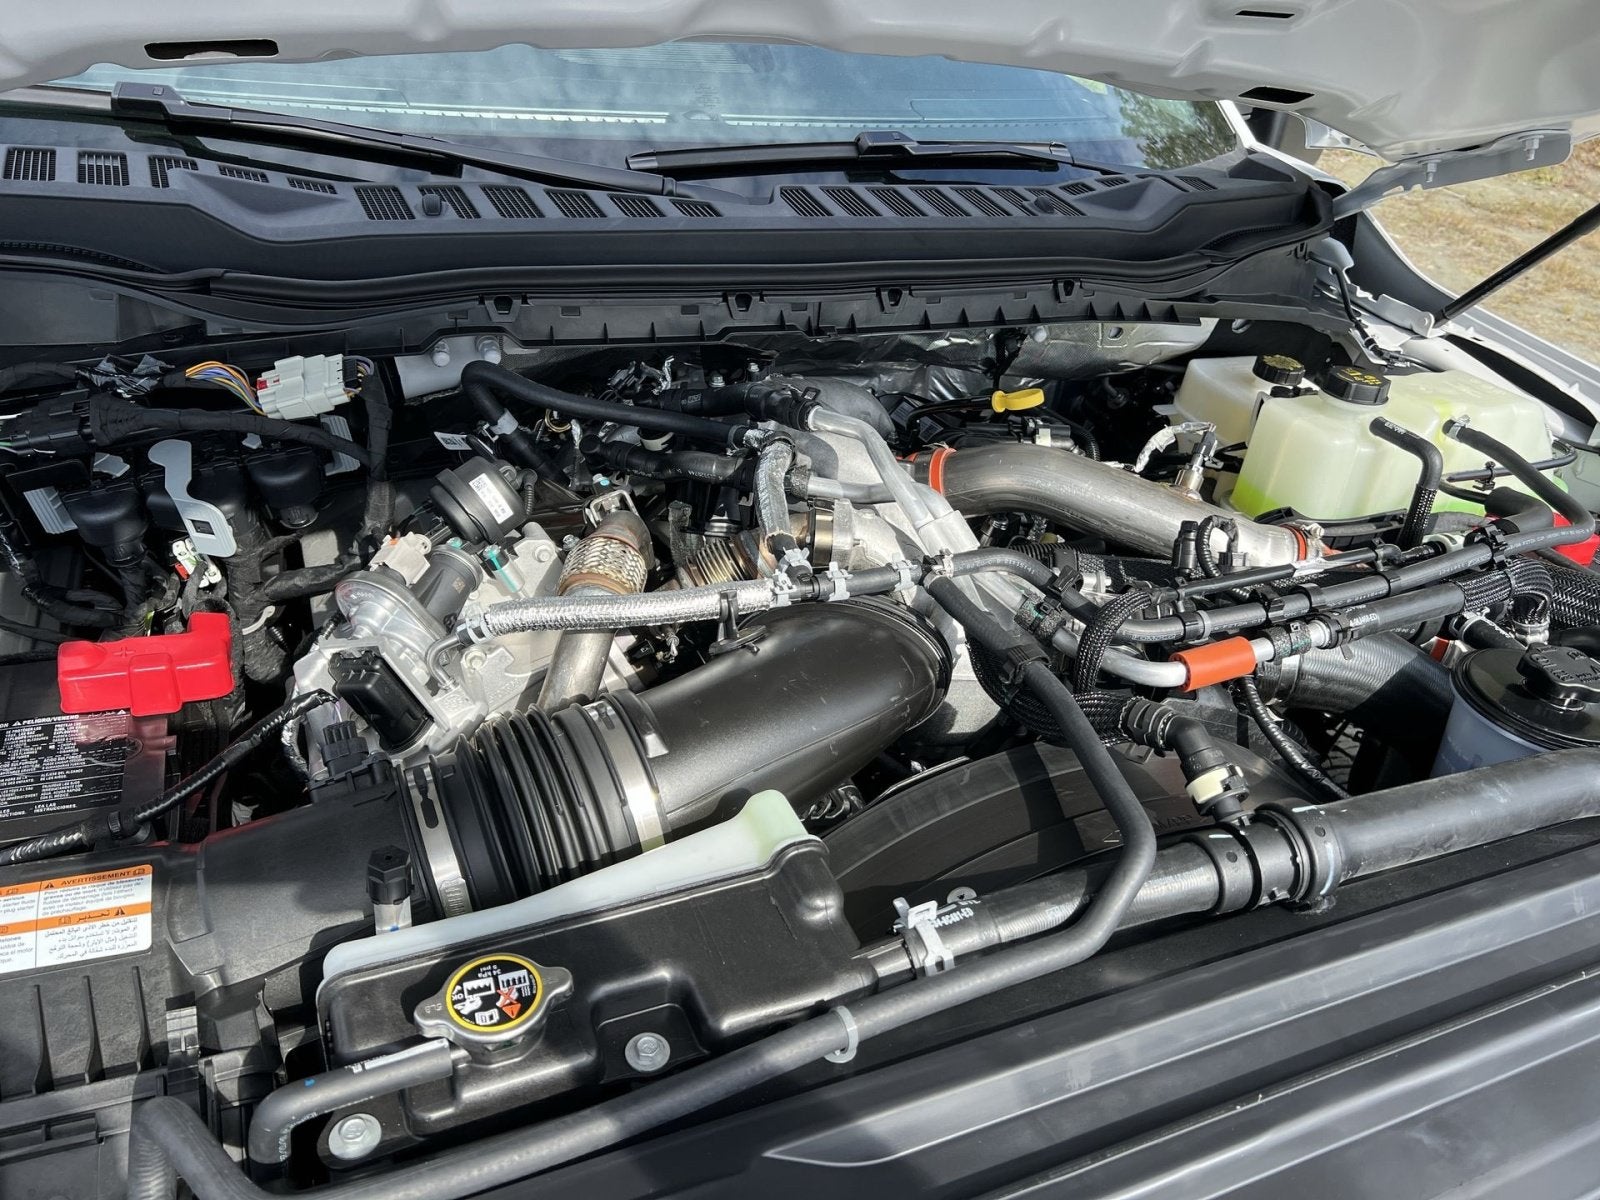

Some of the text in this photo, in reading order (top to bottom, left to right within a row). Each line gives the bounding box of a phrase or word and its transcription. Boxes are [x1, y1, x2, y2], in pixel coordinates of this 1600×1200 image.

[22, 714, 80, 725] PELIGRO/VENENO
[60, 871, 131, 886] AVERTISSEMENT
[451, 993, 464, 1001] OK
